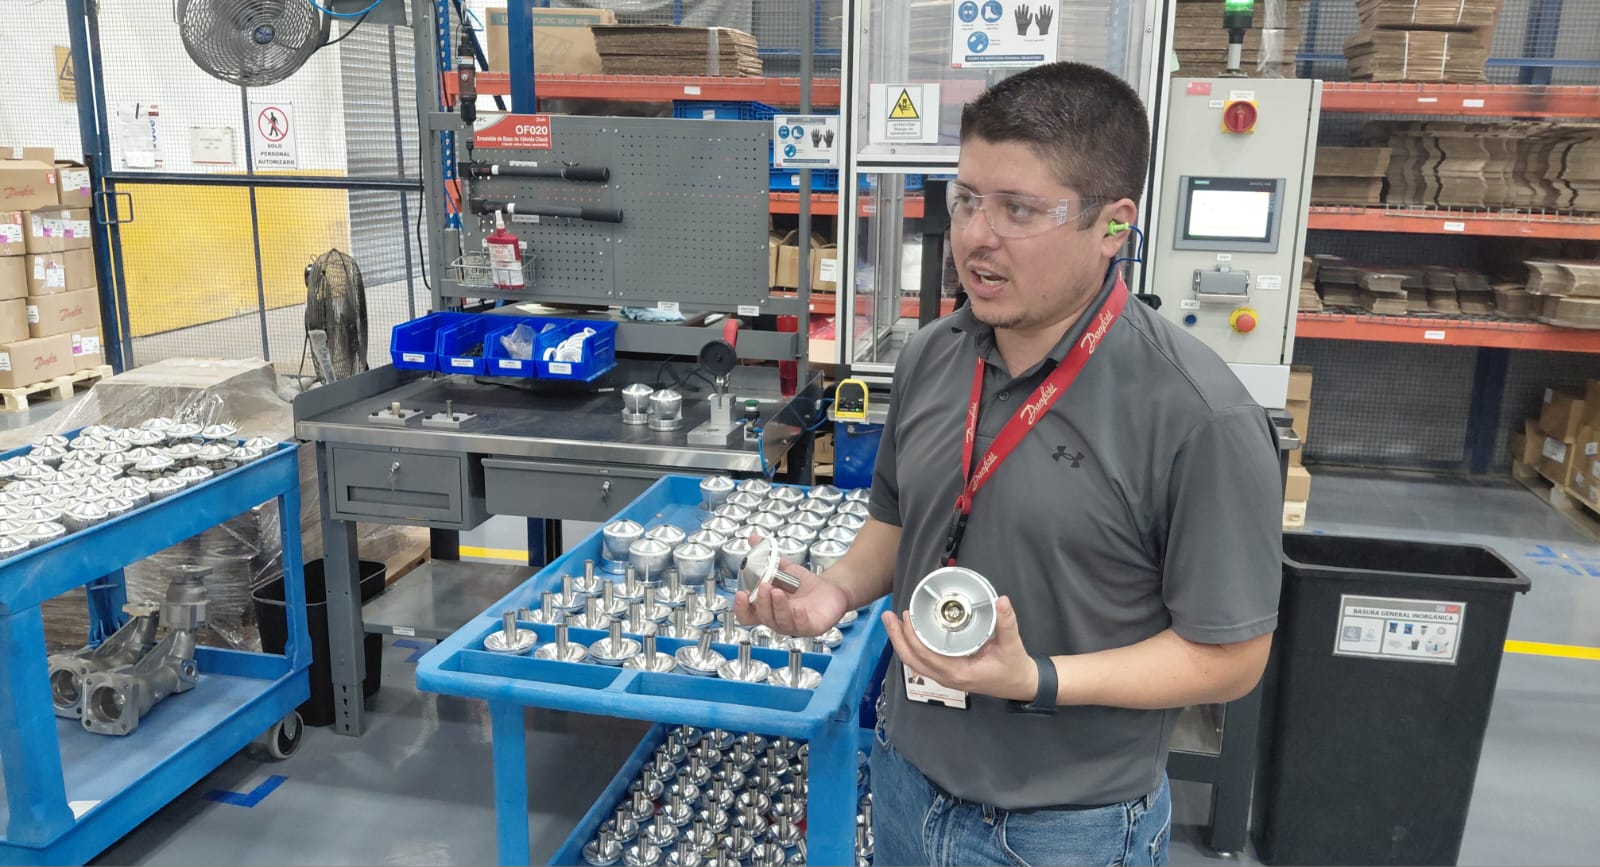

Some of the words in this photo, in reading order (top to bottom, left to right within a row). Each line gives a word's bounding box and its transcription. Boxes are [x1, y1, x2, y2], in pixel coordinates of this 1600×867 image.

[515, 125, 548, 135] OF020
[1080, 309, 1114, 354] Danfoss
[966, 402, 977, 443] Danfoss
[1020, 383, 1058, 426] Danfoss
[967, 452, 998, 492] Danfoss
[1353, 608, 1380, 616] BASURA
[1381, 610, 1411, 618] GENERAL
